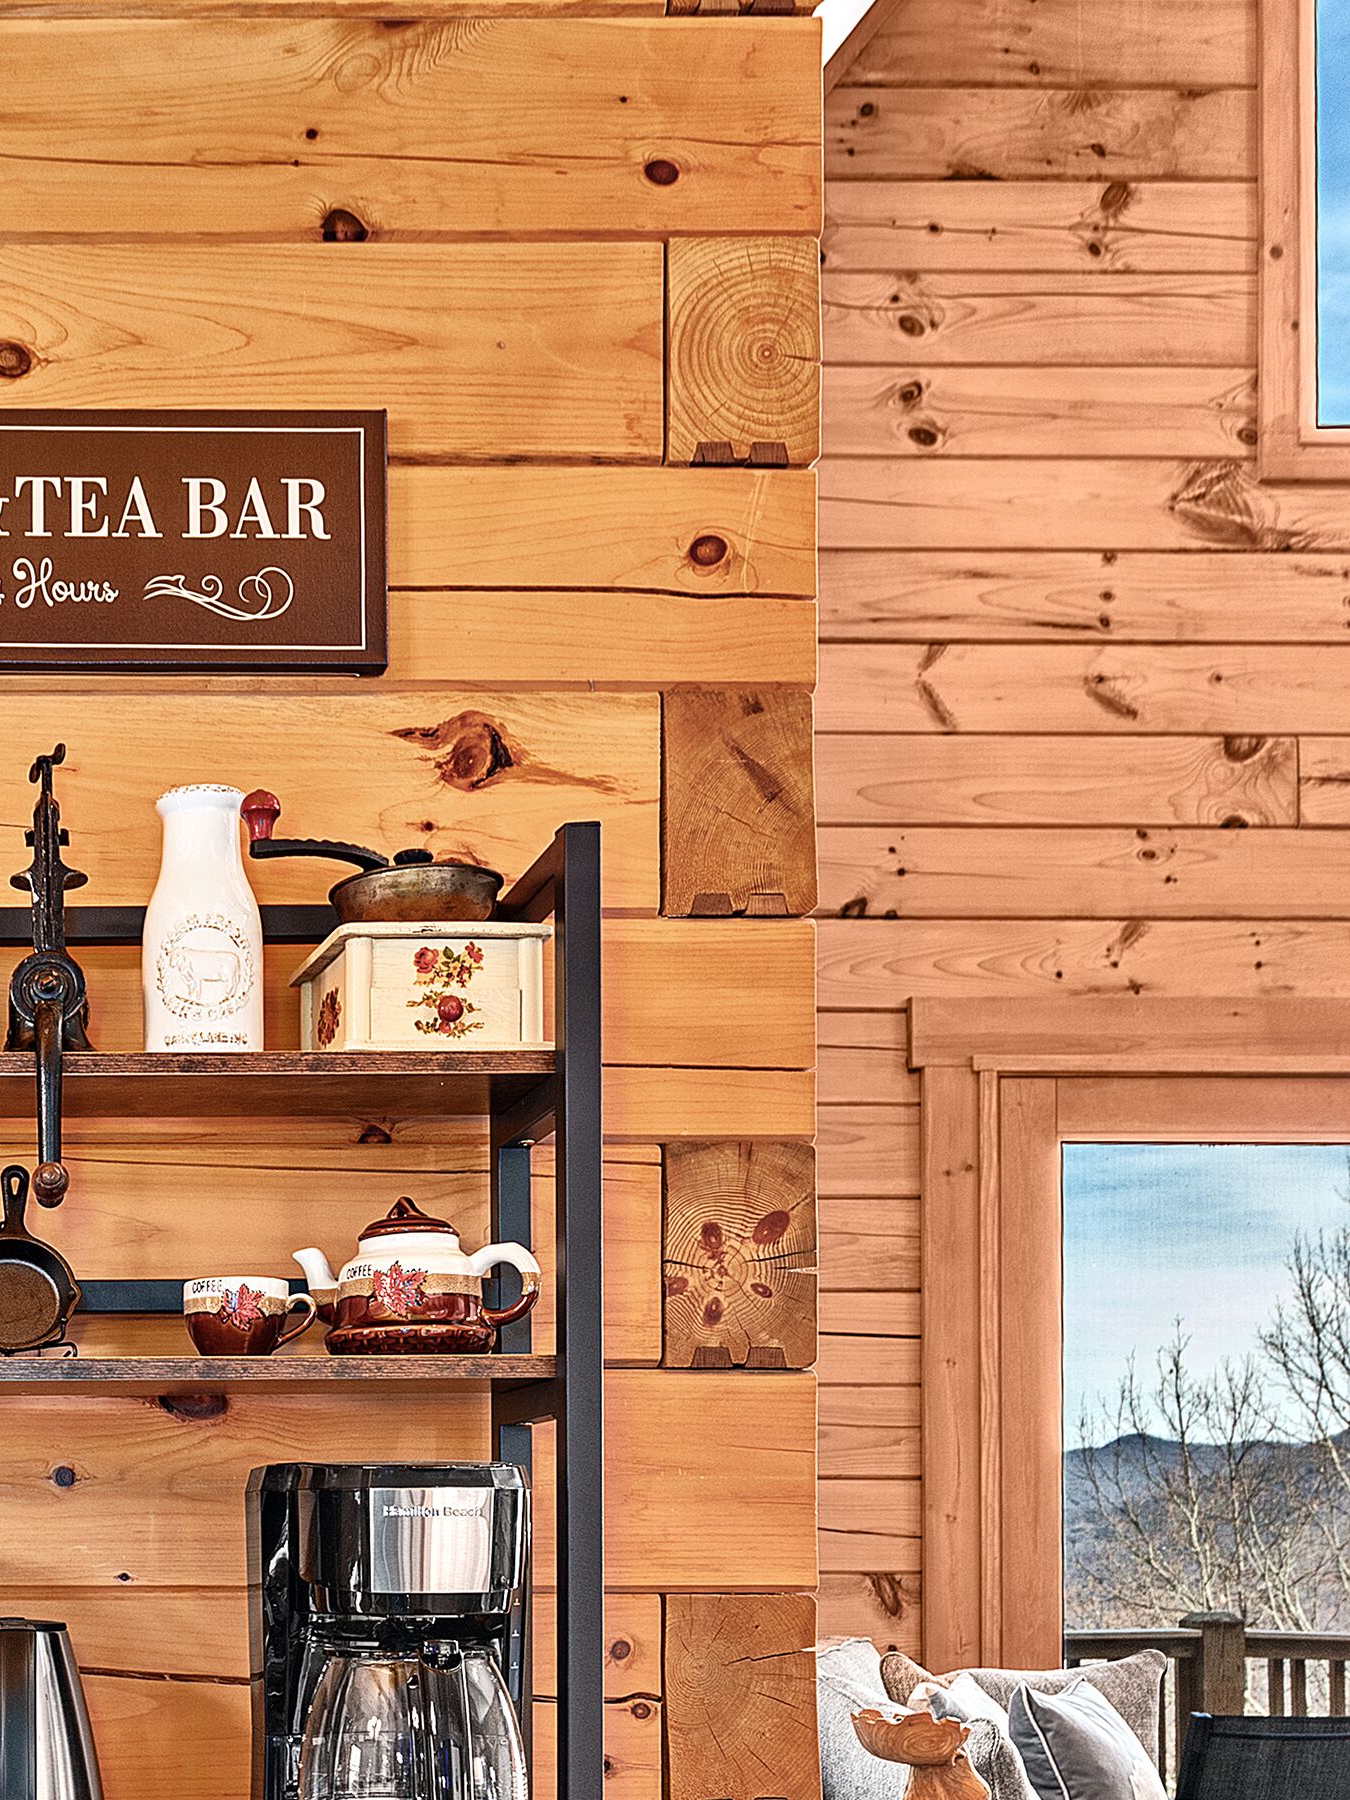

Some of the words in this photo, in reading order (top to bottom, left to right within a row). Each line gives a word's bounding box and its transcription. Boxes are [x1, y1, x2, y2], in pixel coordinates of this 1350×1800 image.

[181, 477, 332, 540] BAR
[12, 557, 120, 609] Hours
[191, 1279, 223, 1294] COFFEE
[346, 1263, 373, 1280] COFFEE
